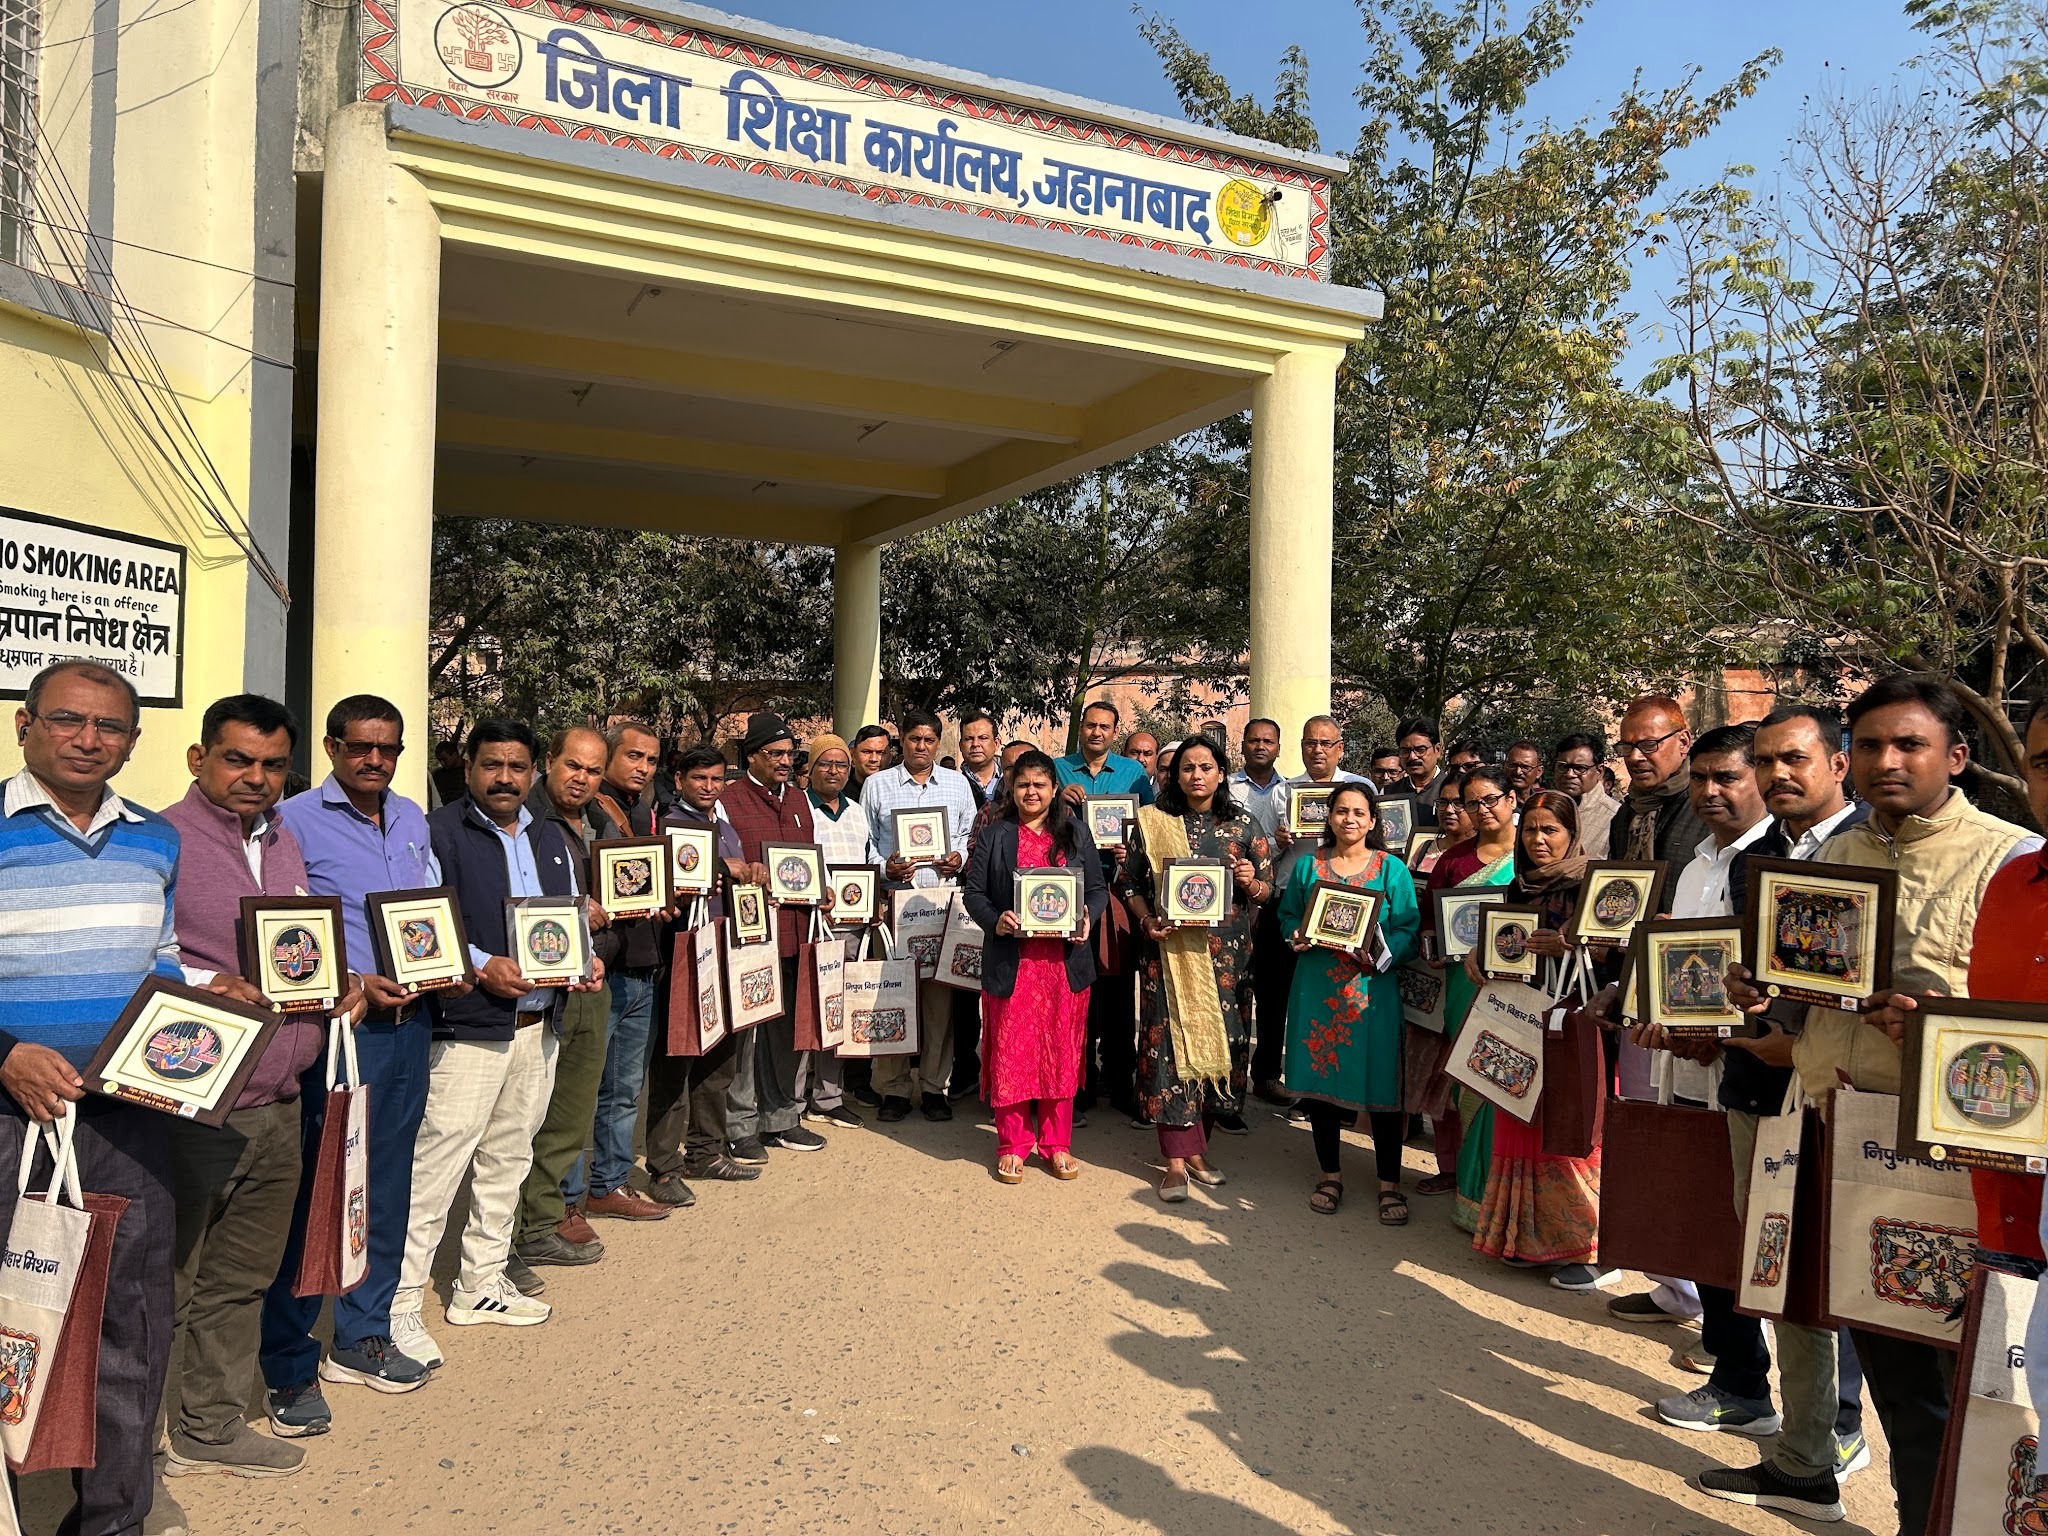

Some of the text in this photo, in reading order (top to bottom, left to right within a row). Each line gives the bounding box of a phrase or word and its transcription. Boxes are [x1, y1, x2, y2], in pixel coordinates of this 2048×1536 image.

[486, 89, 519, 104] सरकार
[537, 28, 692, 130] जिला
[720, 69, 852, 165] शिक्षा
[23, 543, 122, 585] SMOKING
[124, 561, 179, 595] AREA
[51, 587, 78, 603] here
[82, 591, 91, 605] is
[94, 596, 110, 607] an
[114, 596, 159, 613] offence
[65, 604, 129, 650] निषेध
[132, 613, 170, 656] क्षेत्र
[1487, 993, 1506, 1011] निपुण
[1507, 1003, 1528, 1021] बिहार
[23, 1249, 61, 1275] मिशन
